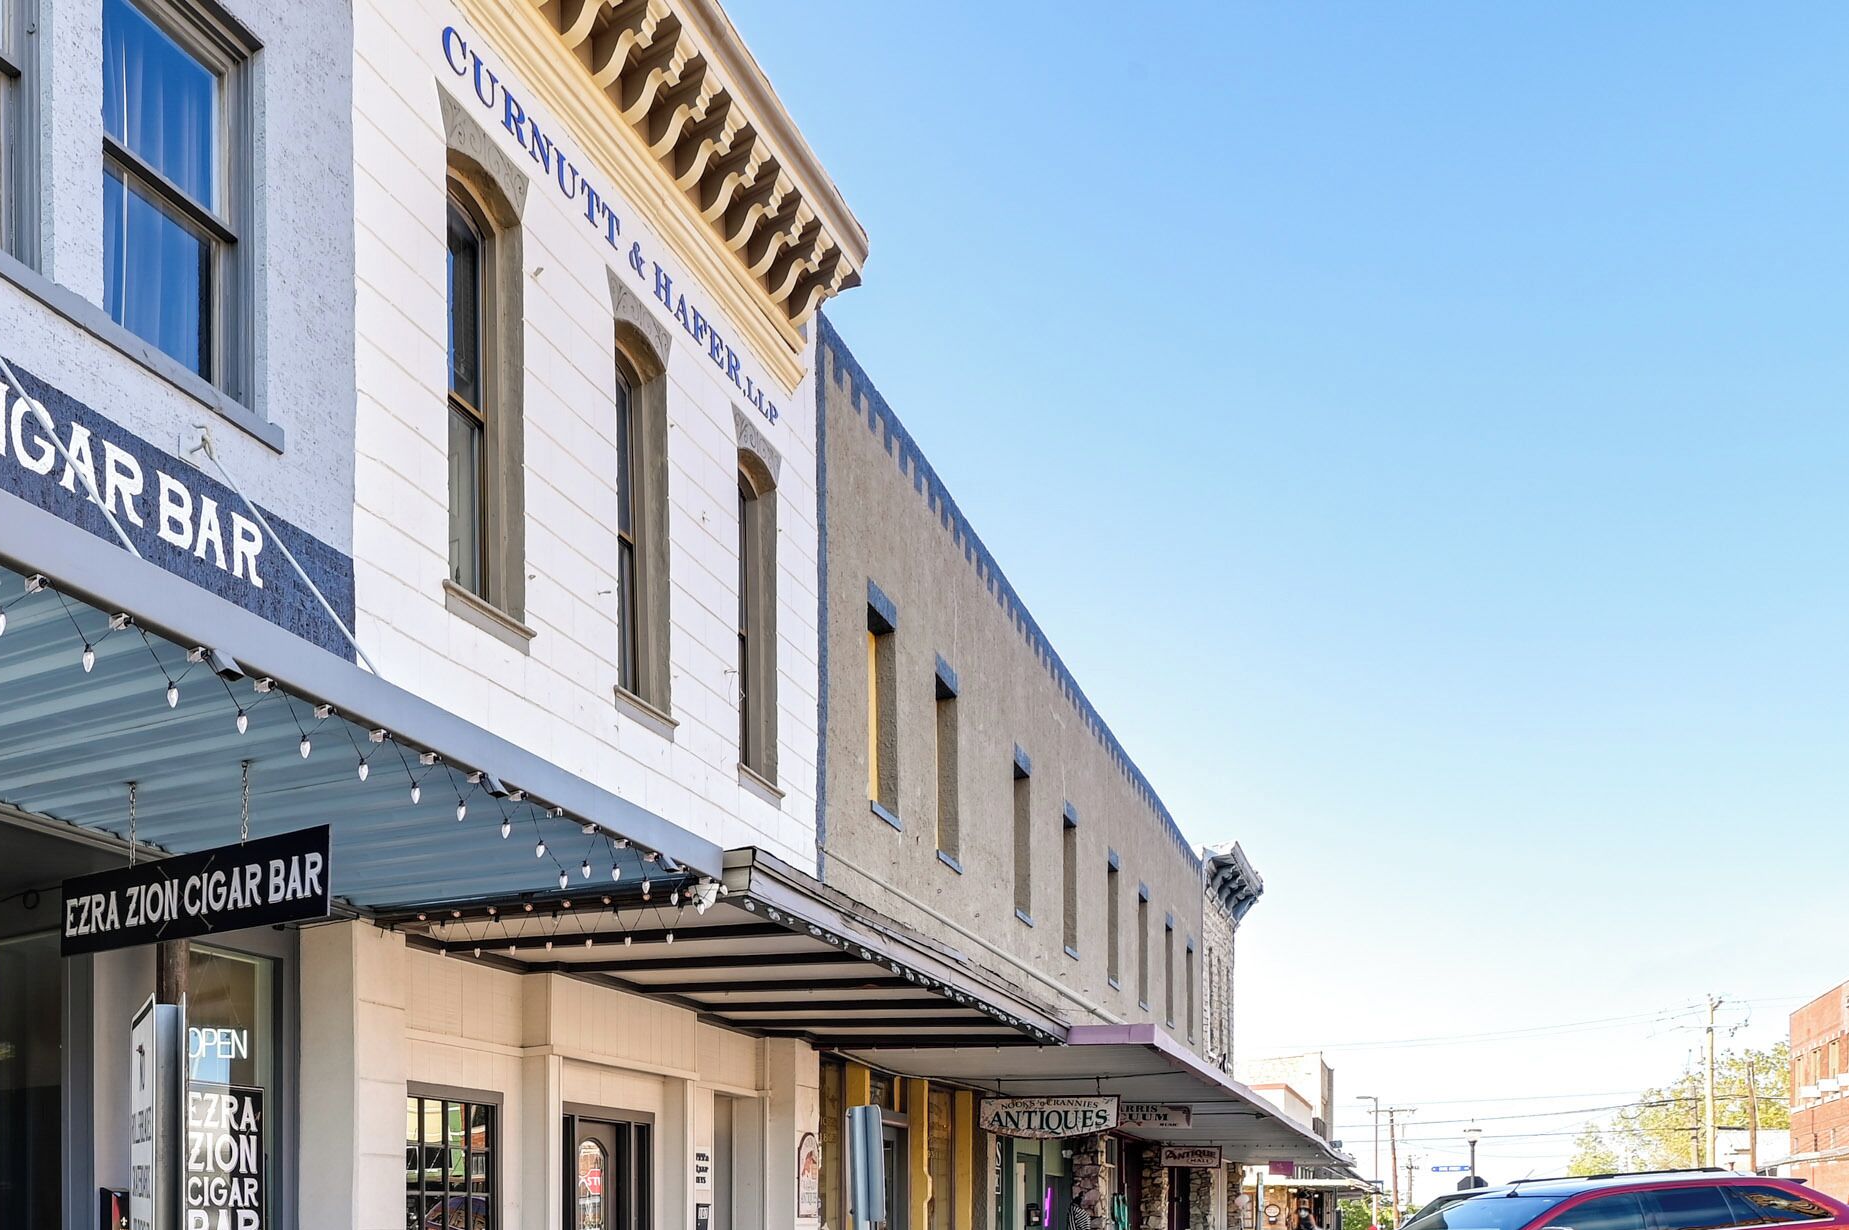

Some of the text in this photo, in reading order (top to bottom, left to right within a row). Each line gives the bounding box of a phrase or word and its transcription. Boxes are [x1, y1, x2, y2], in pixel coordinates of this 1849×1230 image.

[442, 26, 621, 251] CURNUTT
[628, 241, 645, 280] &
[156, 469, 264, 589] BAR
[65, 852, 323, 938] EZRA ZION CIGAR BAR
[189, 1027, 248, 1059] OPEN
[189, 1091, 258, 1132] EZRA
[991, 1109, 1108, 1134] ANTIQUES
[1046, 1099, 1098, 1109] CRANNIES
[188, 1131, 258, 1174] ZION
[1165, 1150, 1216, 1160] ANTIQUE
[188, 1177, 259, 1208] CIGAR
